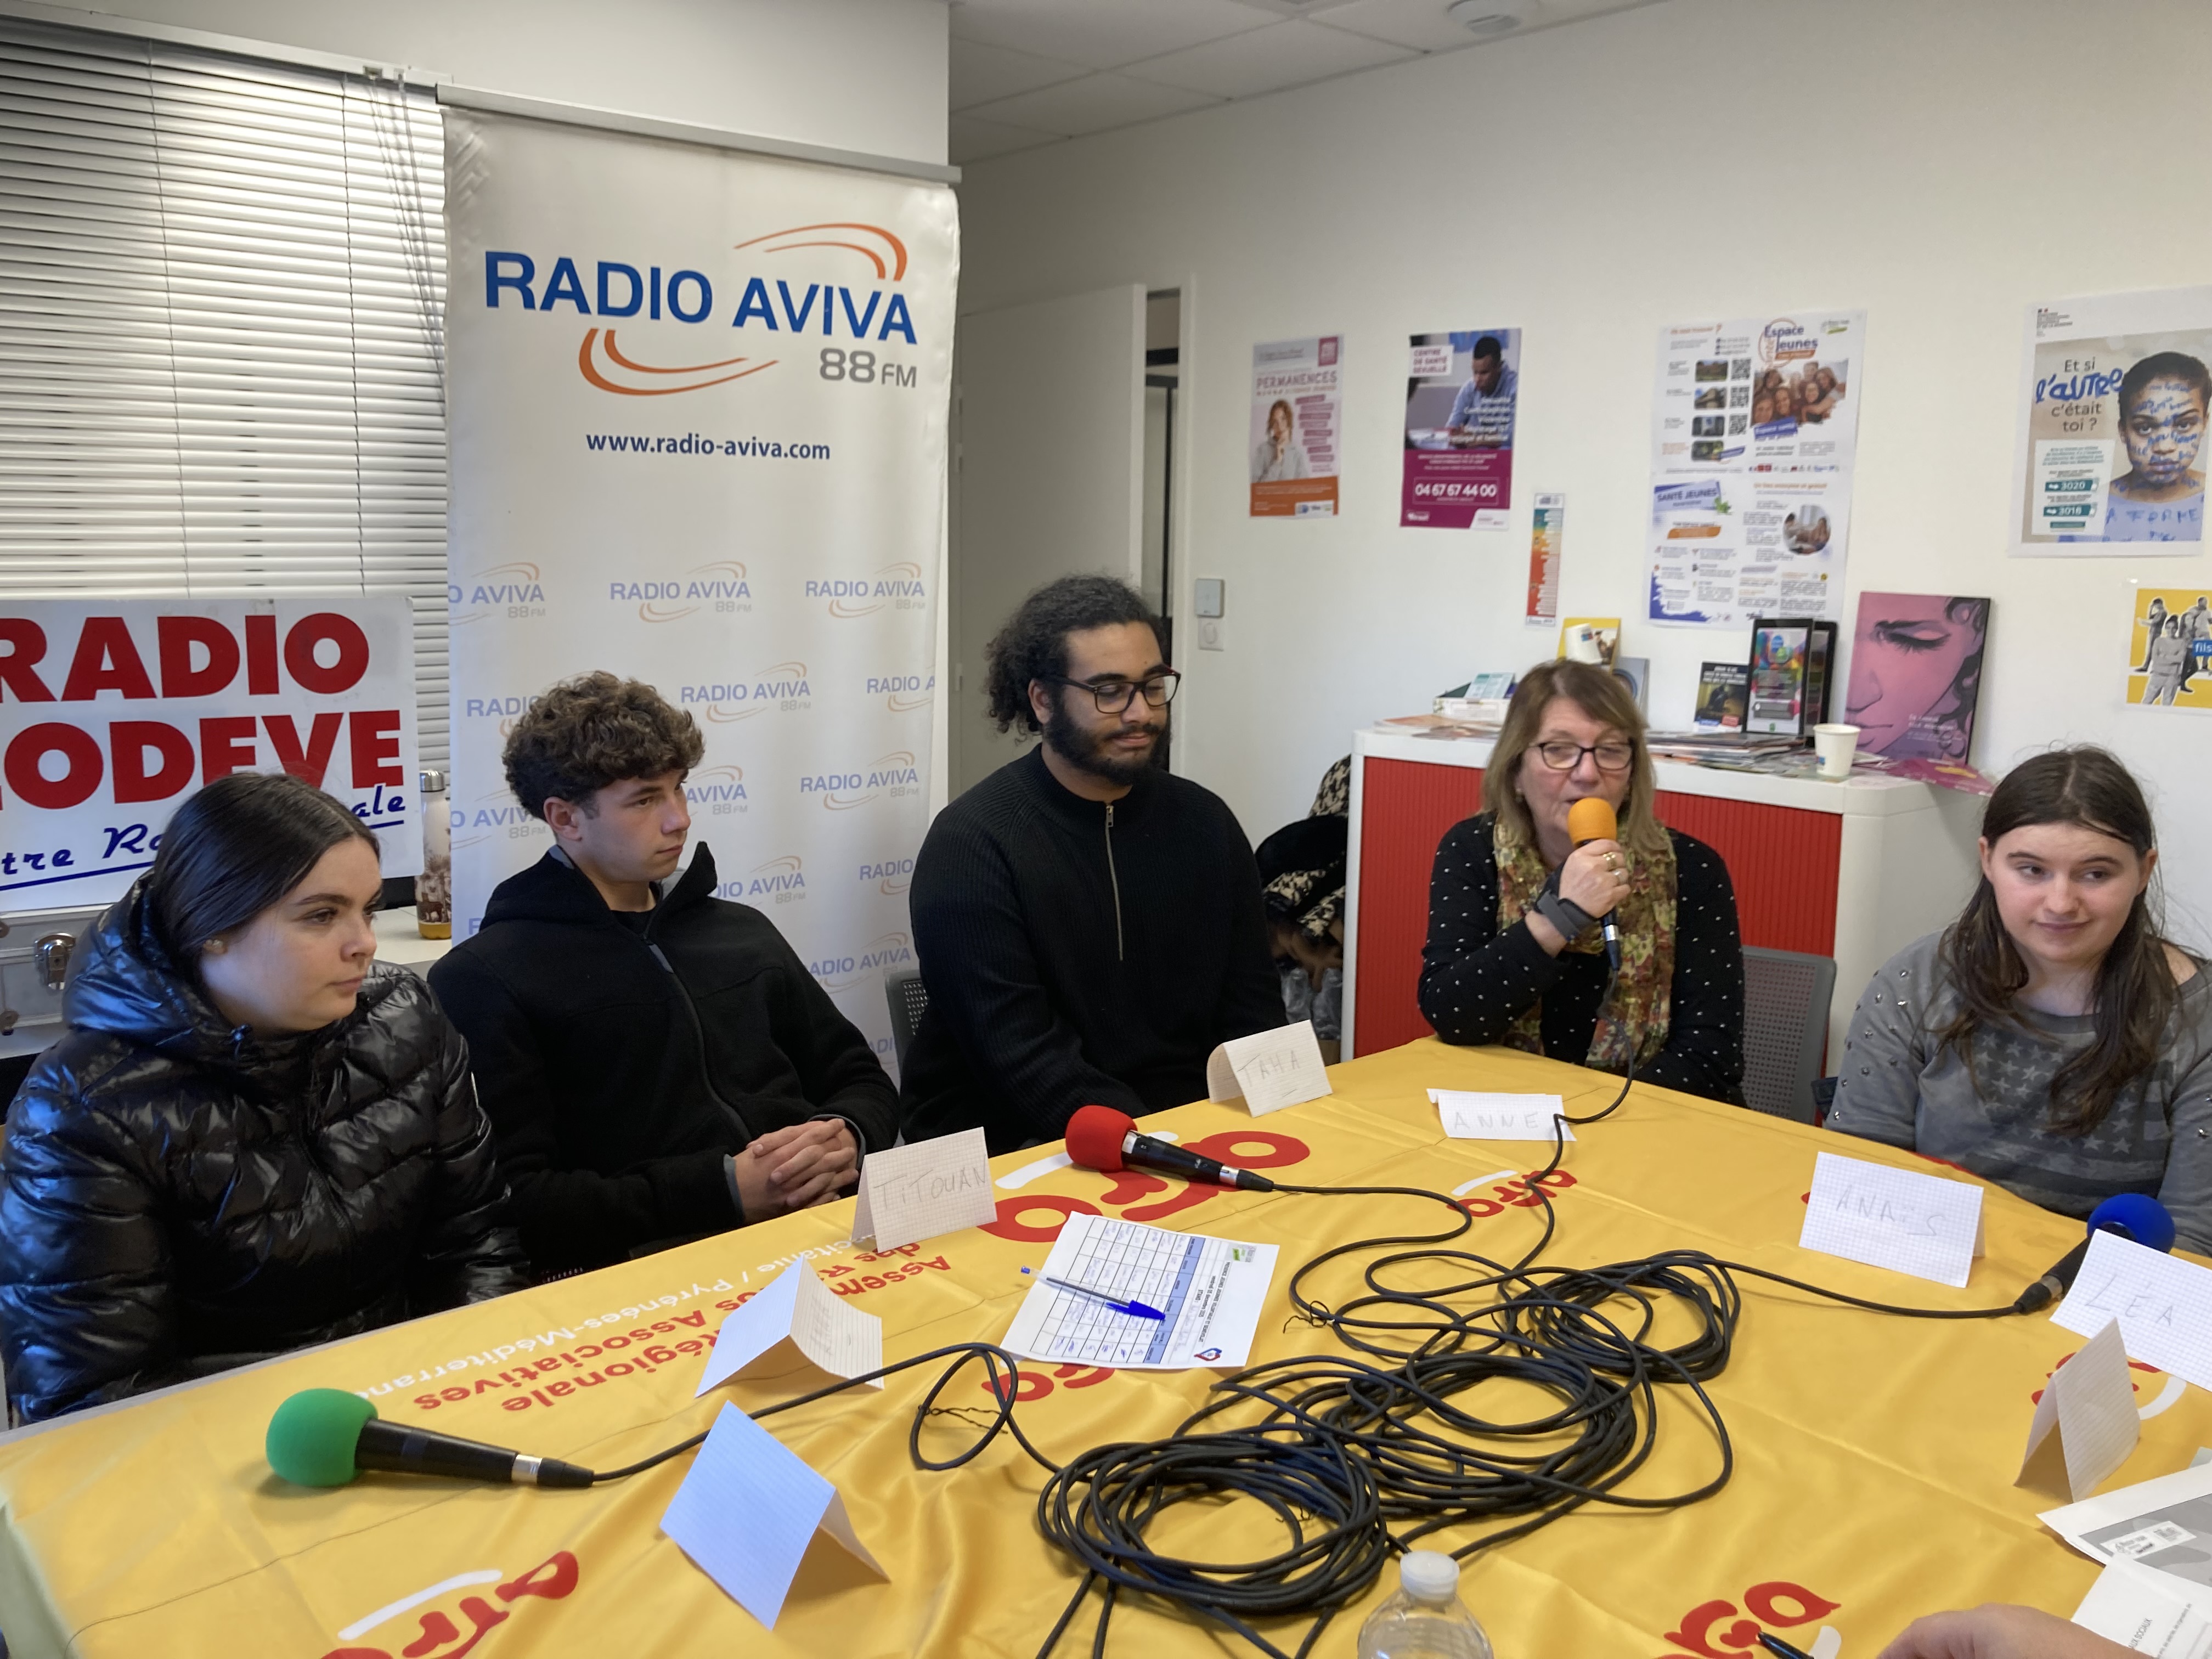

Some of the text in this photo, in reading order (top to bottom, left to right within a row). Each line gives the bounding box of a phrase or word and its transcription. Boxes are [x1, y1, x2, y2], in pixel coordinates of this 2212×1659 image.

[485, 251, 917, 344] RADIO AVIVA
[1764, 325, 1804, 338] Espace
[2064, 357, 2096, 373] Et si
[2051, 402, 2102, 417] c'était
[2063, 419, 2084, 433] toi
[587, 433, 830, 460] www.radio-aviva.com
[1414, 483, 1497, 496] 04 67 67 44 00
[2061, 481, 2085, 490] 3020
[471, 584, 545, 604] AVIVA
[610, 582, 751, 601] RADIO AVIVA
[805, 581, 925, 597] RADIO AVIVA
[0, 613, 369, 703] RADIO
[681, 680, 810, 704] RADIO AVIVA
[867, 676, 919, 695] RADIO
[466, 696, 535, 718] RADI
[0, 710, 403, 811] ODEVE
[800, 769, 918, 793] RADIO AVIVA
[685, 784, 747, 804] AVIVA
[474, 806, 537, 827] AVIV
[860, 860, 915, 880] RADIO
[712, 873, 805, 900] DIO AVIVA
[809, 946, 910, 975] ADIO AVIVA
[1454, 1111, 1539, 1129] ANNE
[359, 1278, 733, 1400] Pyrénées-Méditerran
[414, 1310, 707, 1410] Associatives
